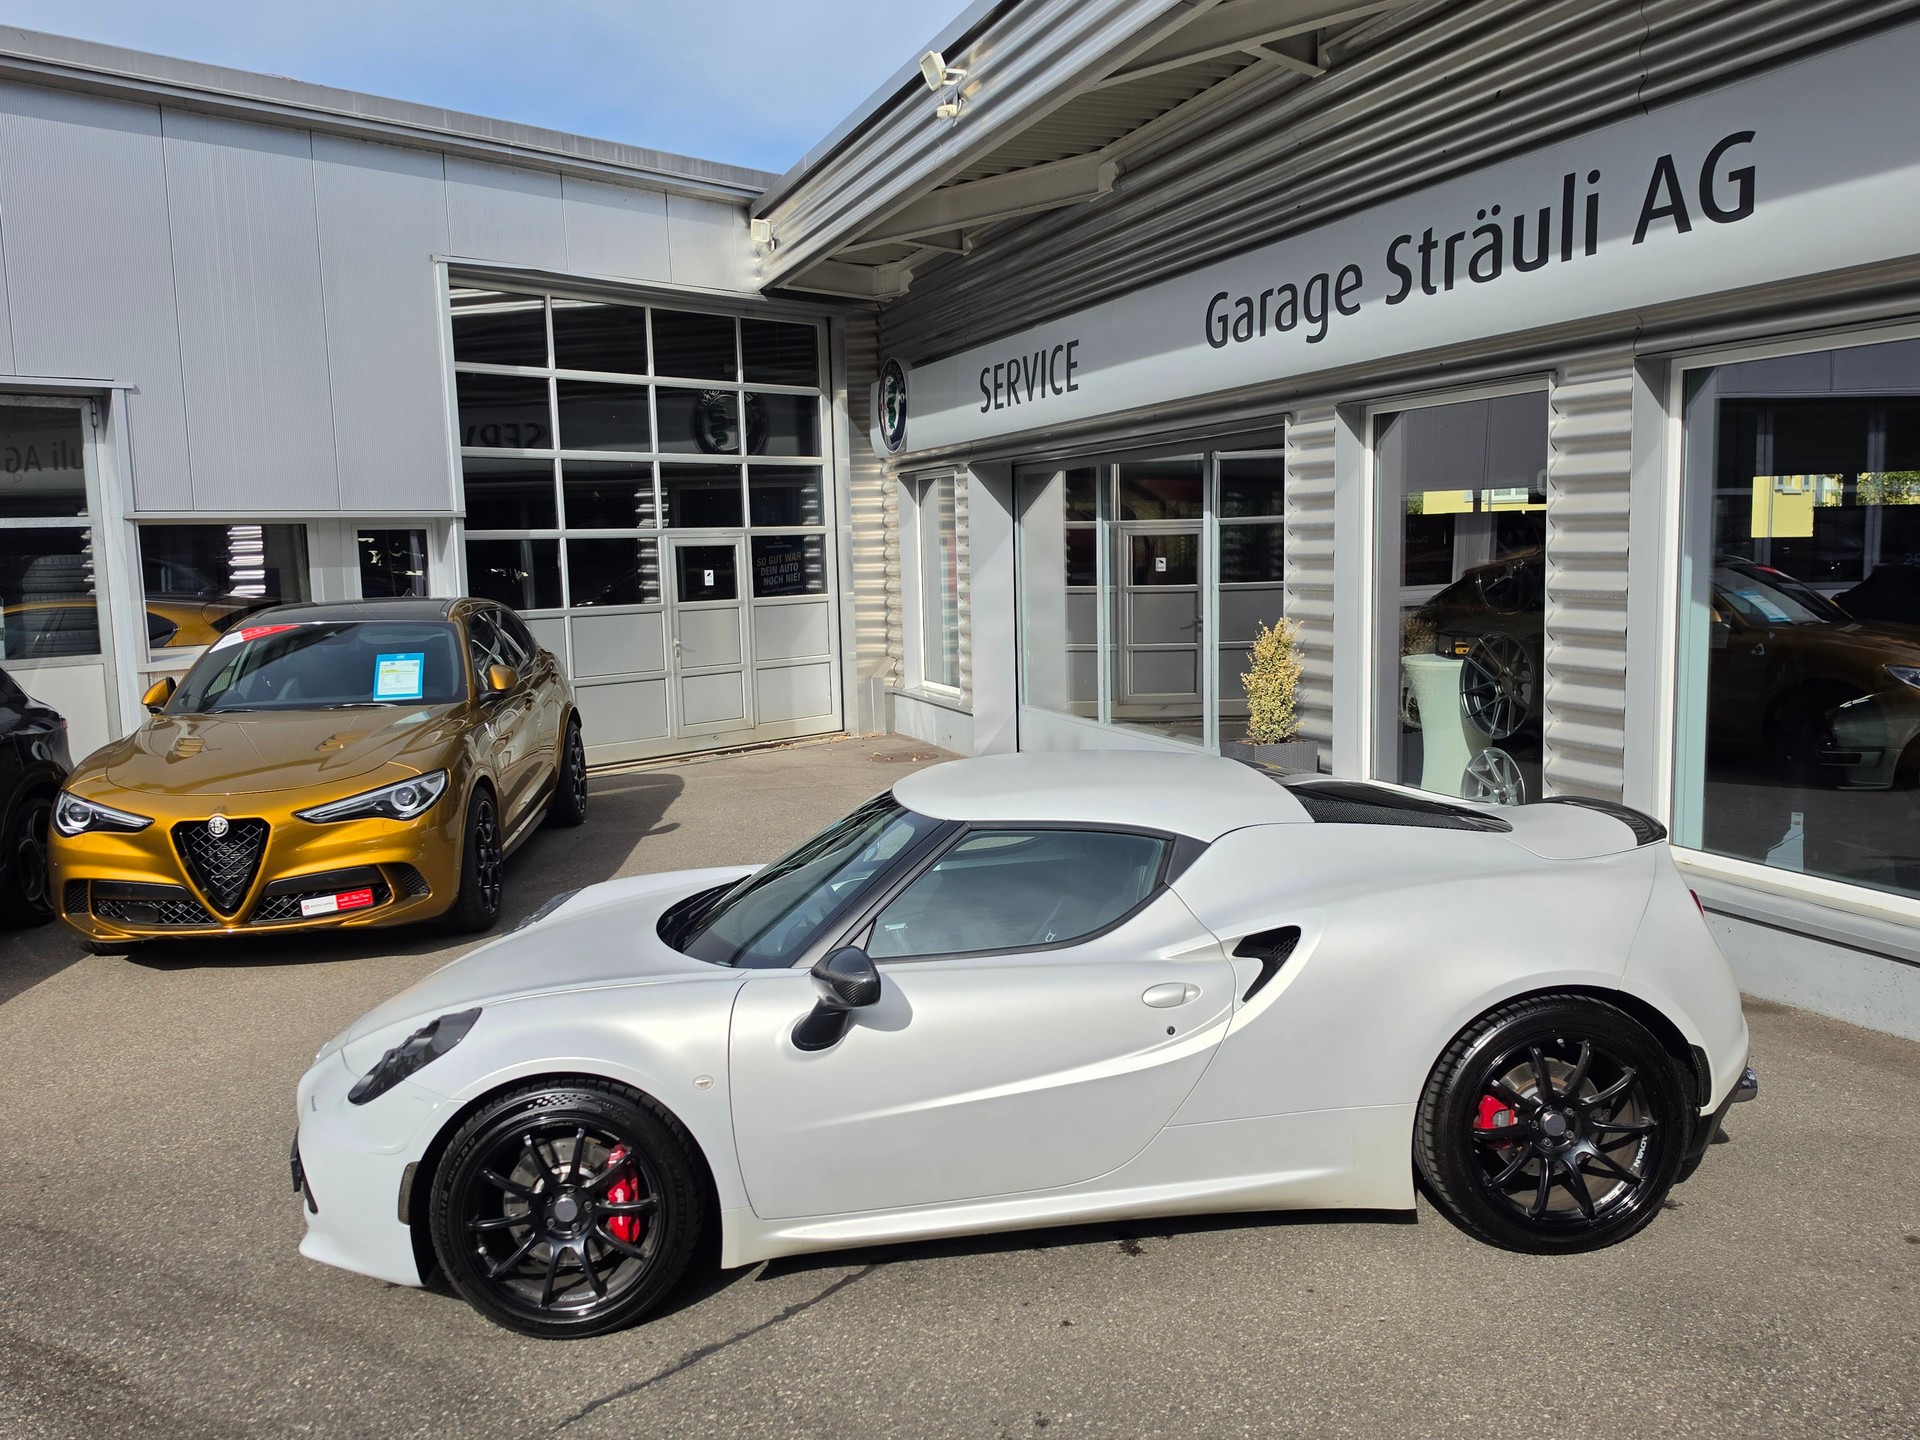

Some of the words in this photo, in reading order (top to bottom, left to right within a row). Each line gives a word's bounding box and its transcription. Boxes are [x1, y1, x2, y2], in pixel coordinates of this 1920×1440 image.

[1205, 263, 1363, 349] Garage
[1385, 168, 1602, 305] Sträuli
[1631, 130, 1756, 246] AG
[979, 339, 1079, 414] SERVICE
[756, 557, 767, 567] SO
[768, 554, 783, 566] GUT
[784, 551, 802, 562] WAR
[760, 565, 778, 577] DEIN
[779, 562, 799, 574] AUTO
[763, 574, 784, 587] NOCH
[785, 572, 801, 583] NIE!
[1633, 1134, 1648, 1168] ADVAN
